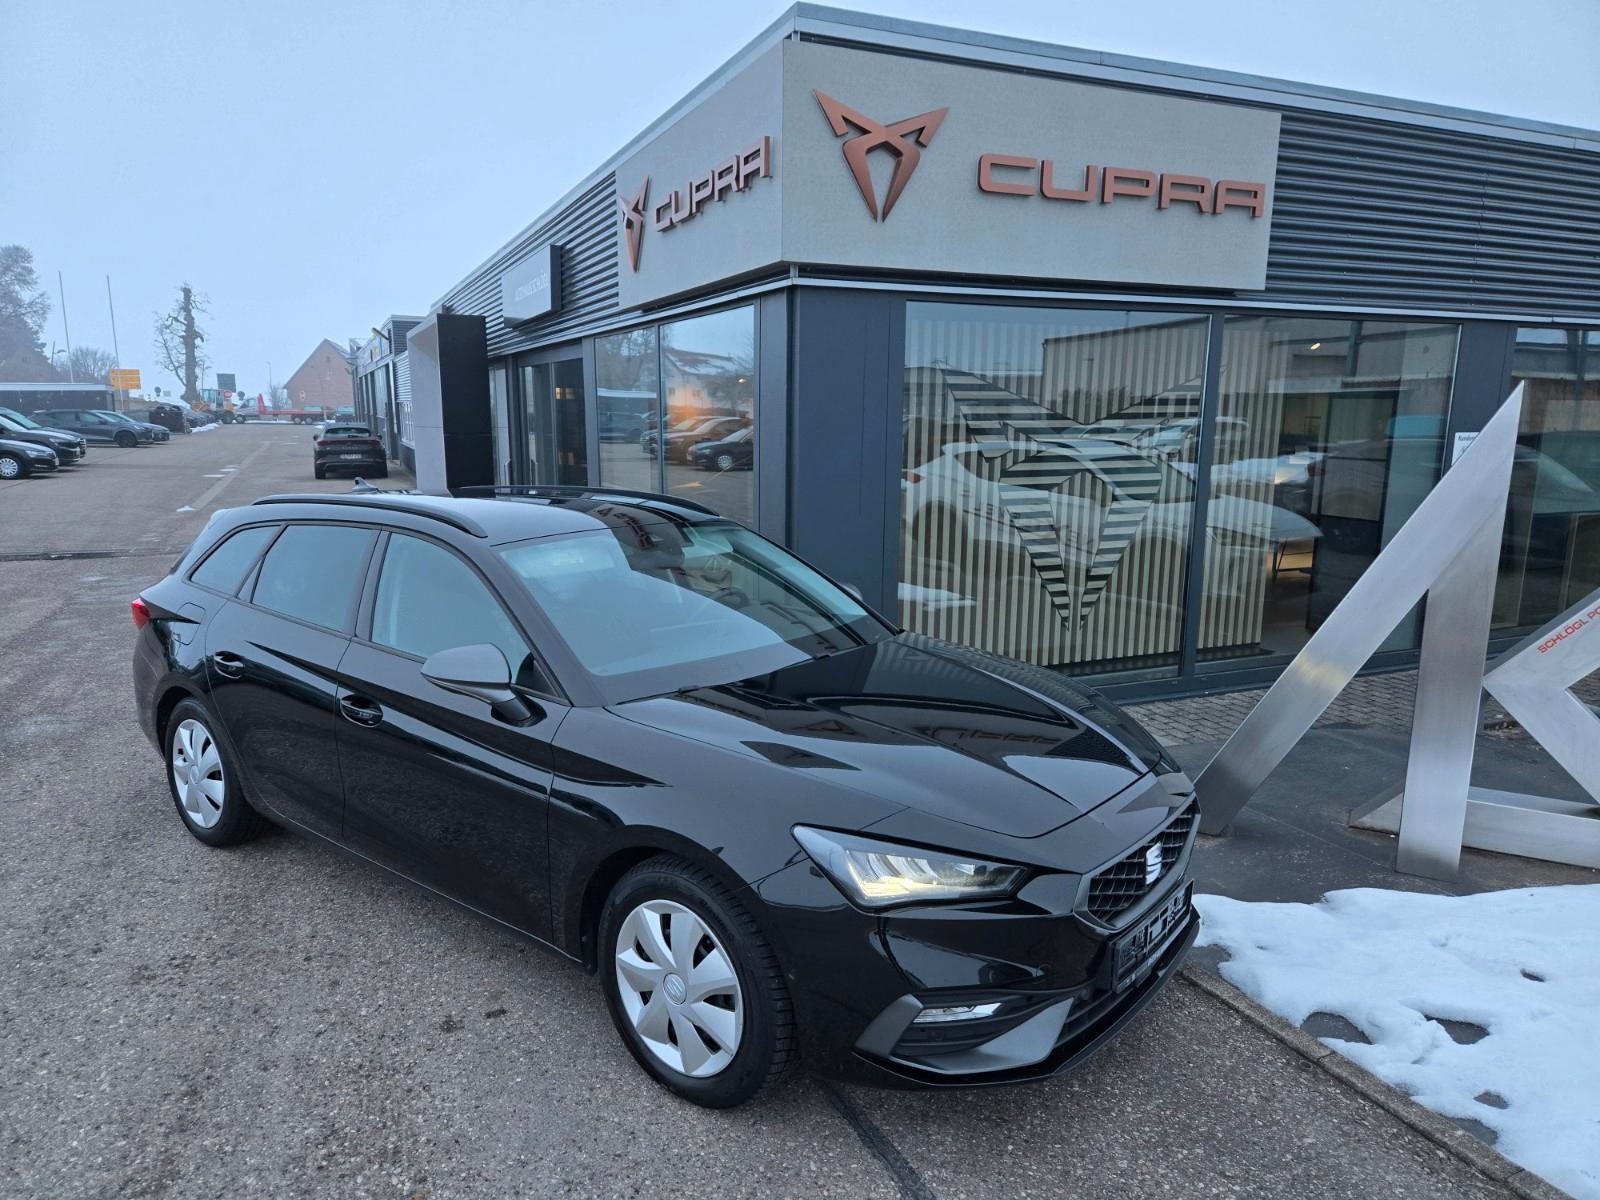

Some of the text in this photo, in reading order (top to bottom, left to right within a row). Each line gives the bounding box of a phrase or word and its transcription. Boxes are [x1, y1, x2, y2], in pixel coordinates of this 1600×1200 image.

[656, 136, 770, 232] CUPRA
[977, 153, 1266, 217] CUPRA
[1537, 619, 1589, 653] SCHLÖGL
